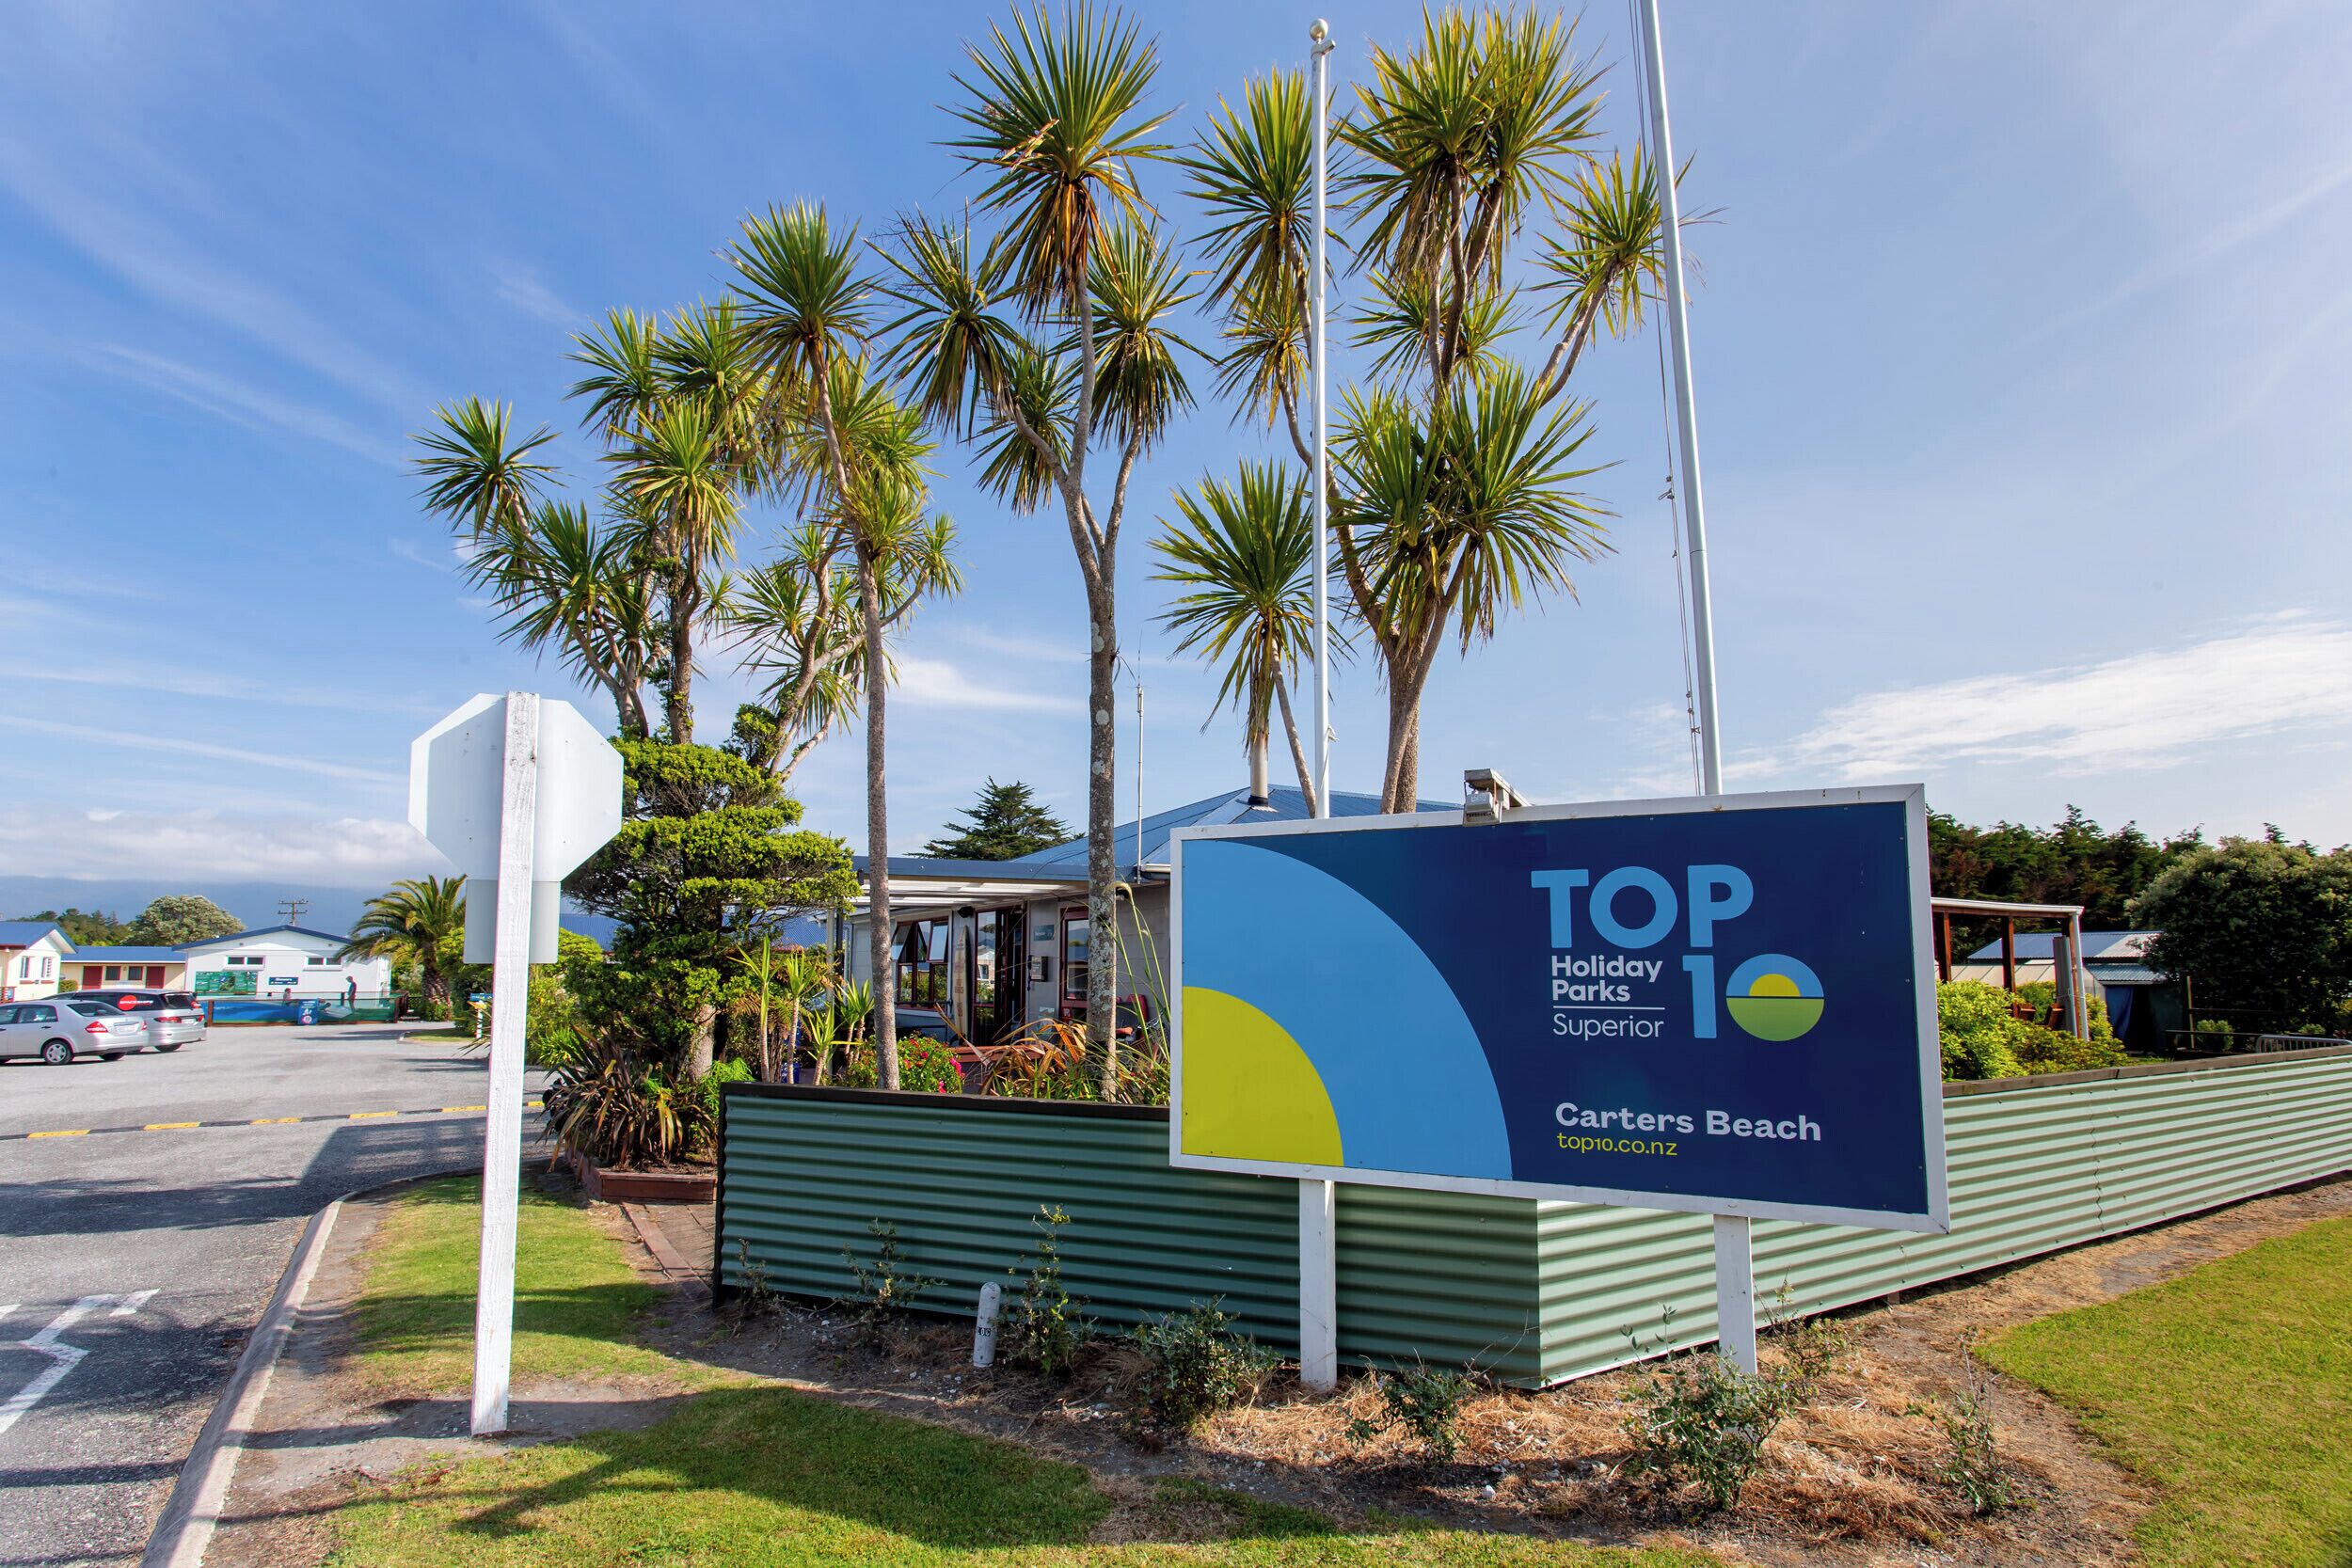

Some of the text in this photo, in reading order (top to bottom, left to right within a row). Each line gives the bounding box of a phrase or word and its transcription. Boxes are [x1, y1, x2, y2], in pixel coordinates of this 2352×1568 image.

[1531, 863, 1754, 949] TOP
[1551, 955, 1663, 983] Holiday
[1552, 979, 1631, 1002] Parks
[1682, 953, 1825, 1042] 10
[1552, 1013, 1664, 1041] Superior
[1555, 1102, 1821, 1141] Carters Beach
[1557, 1132, 1677, 1156] top10.co.nz
